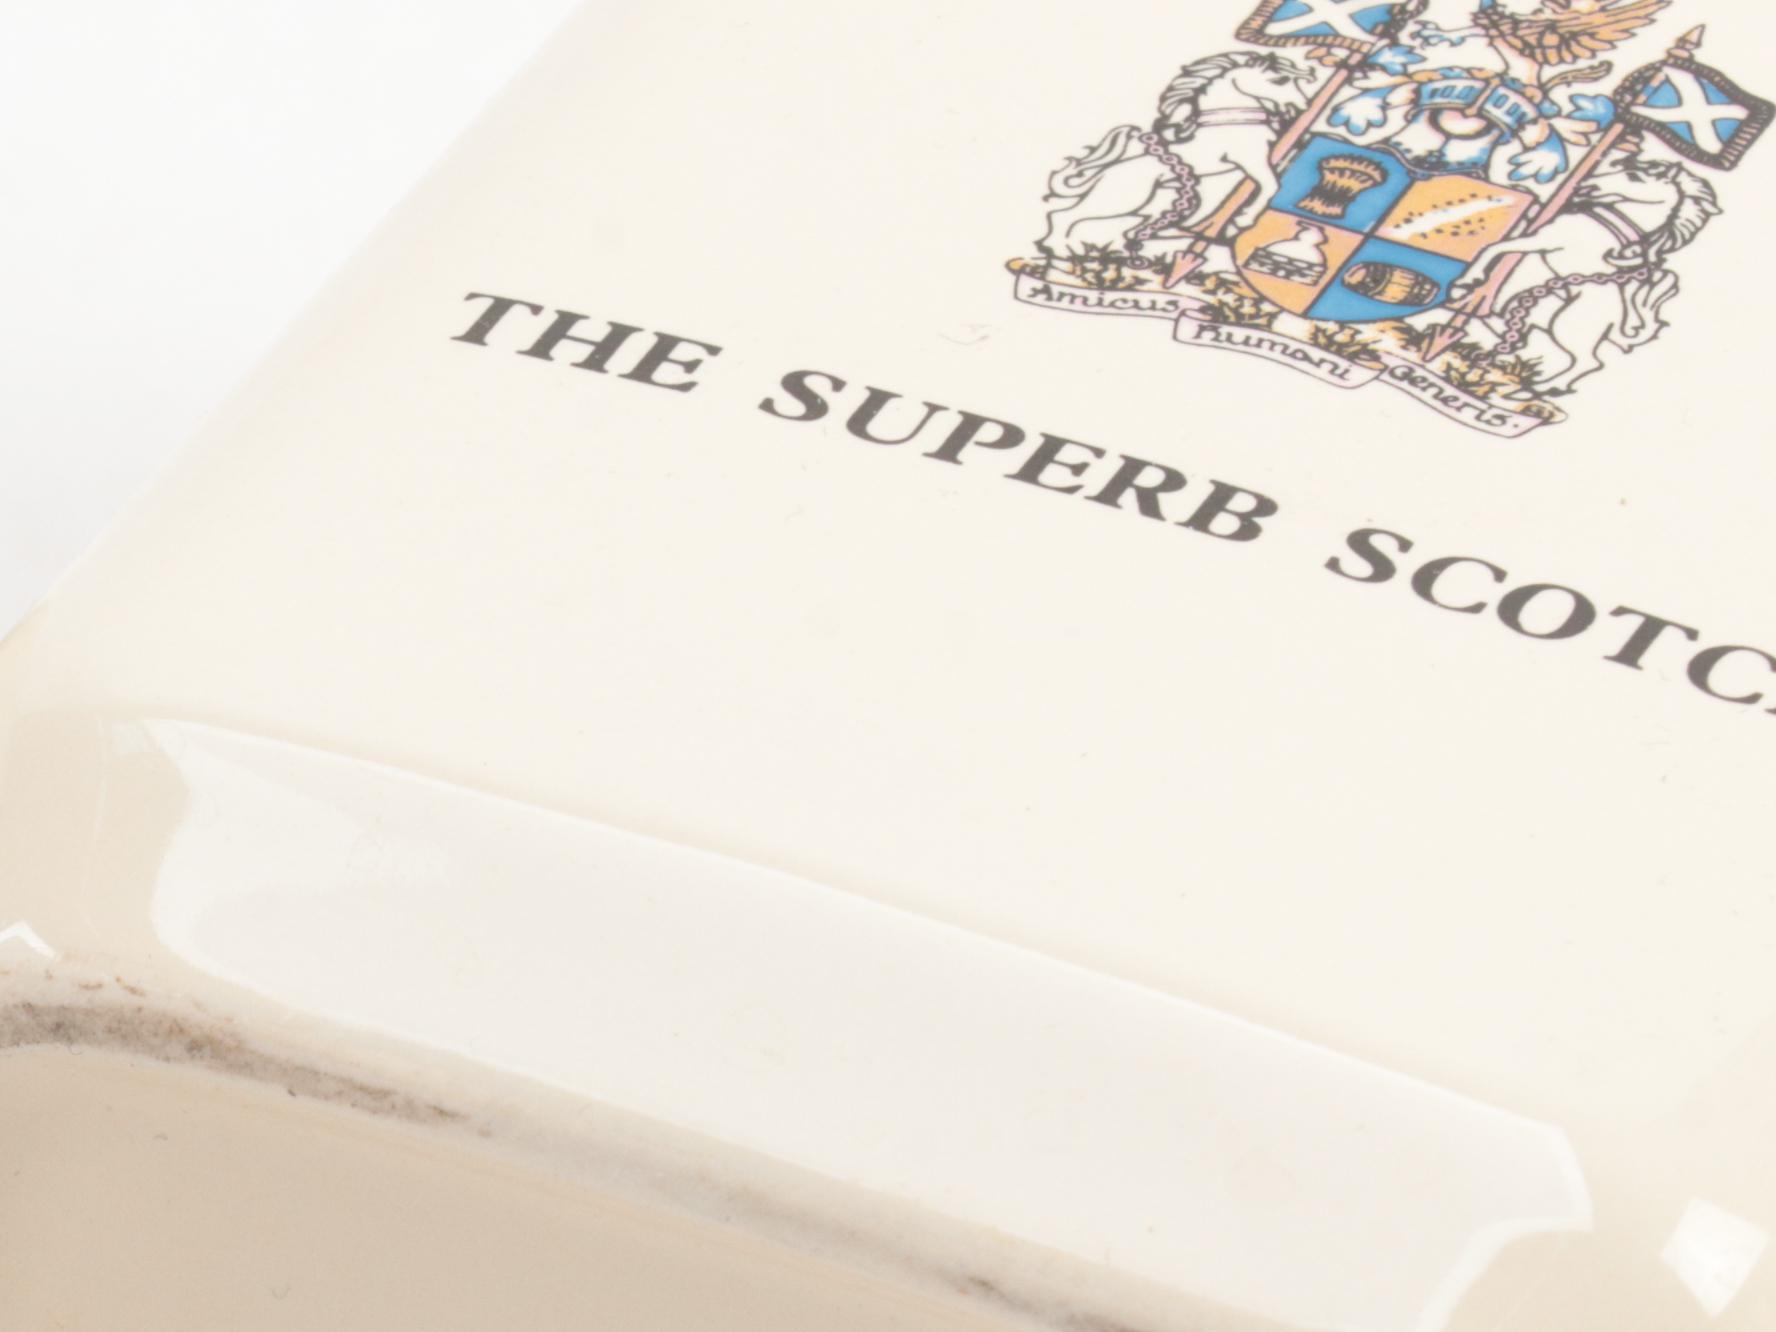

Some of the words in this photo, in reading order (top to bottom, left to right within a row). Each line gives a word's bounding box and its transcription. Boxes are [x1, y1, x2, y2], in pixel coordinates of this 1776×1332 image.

[1027, 282, 1180, 313] Amicus
[450, 292, 723, 394] THE
[758, 368, 1279, 543] SUPERB
[1323, 527, 1776, 716] SCOTC
